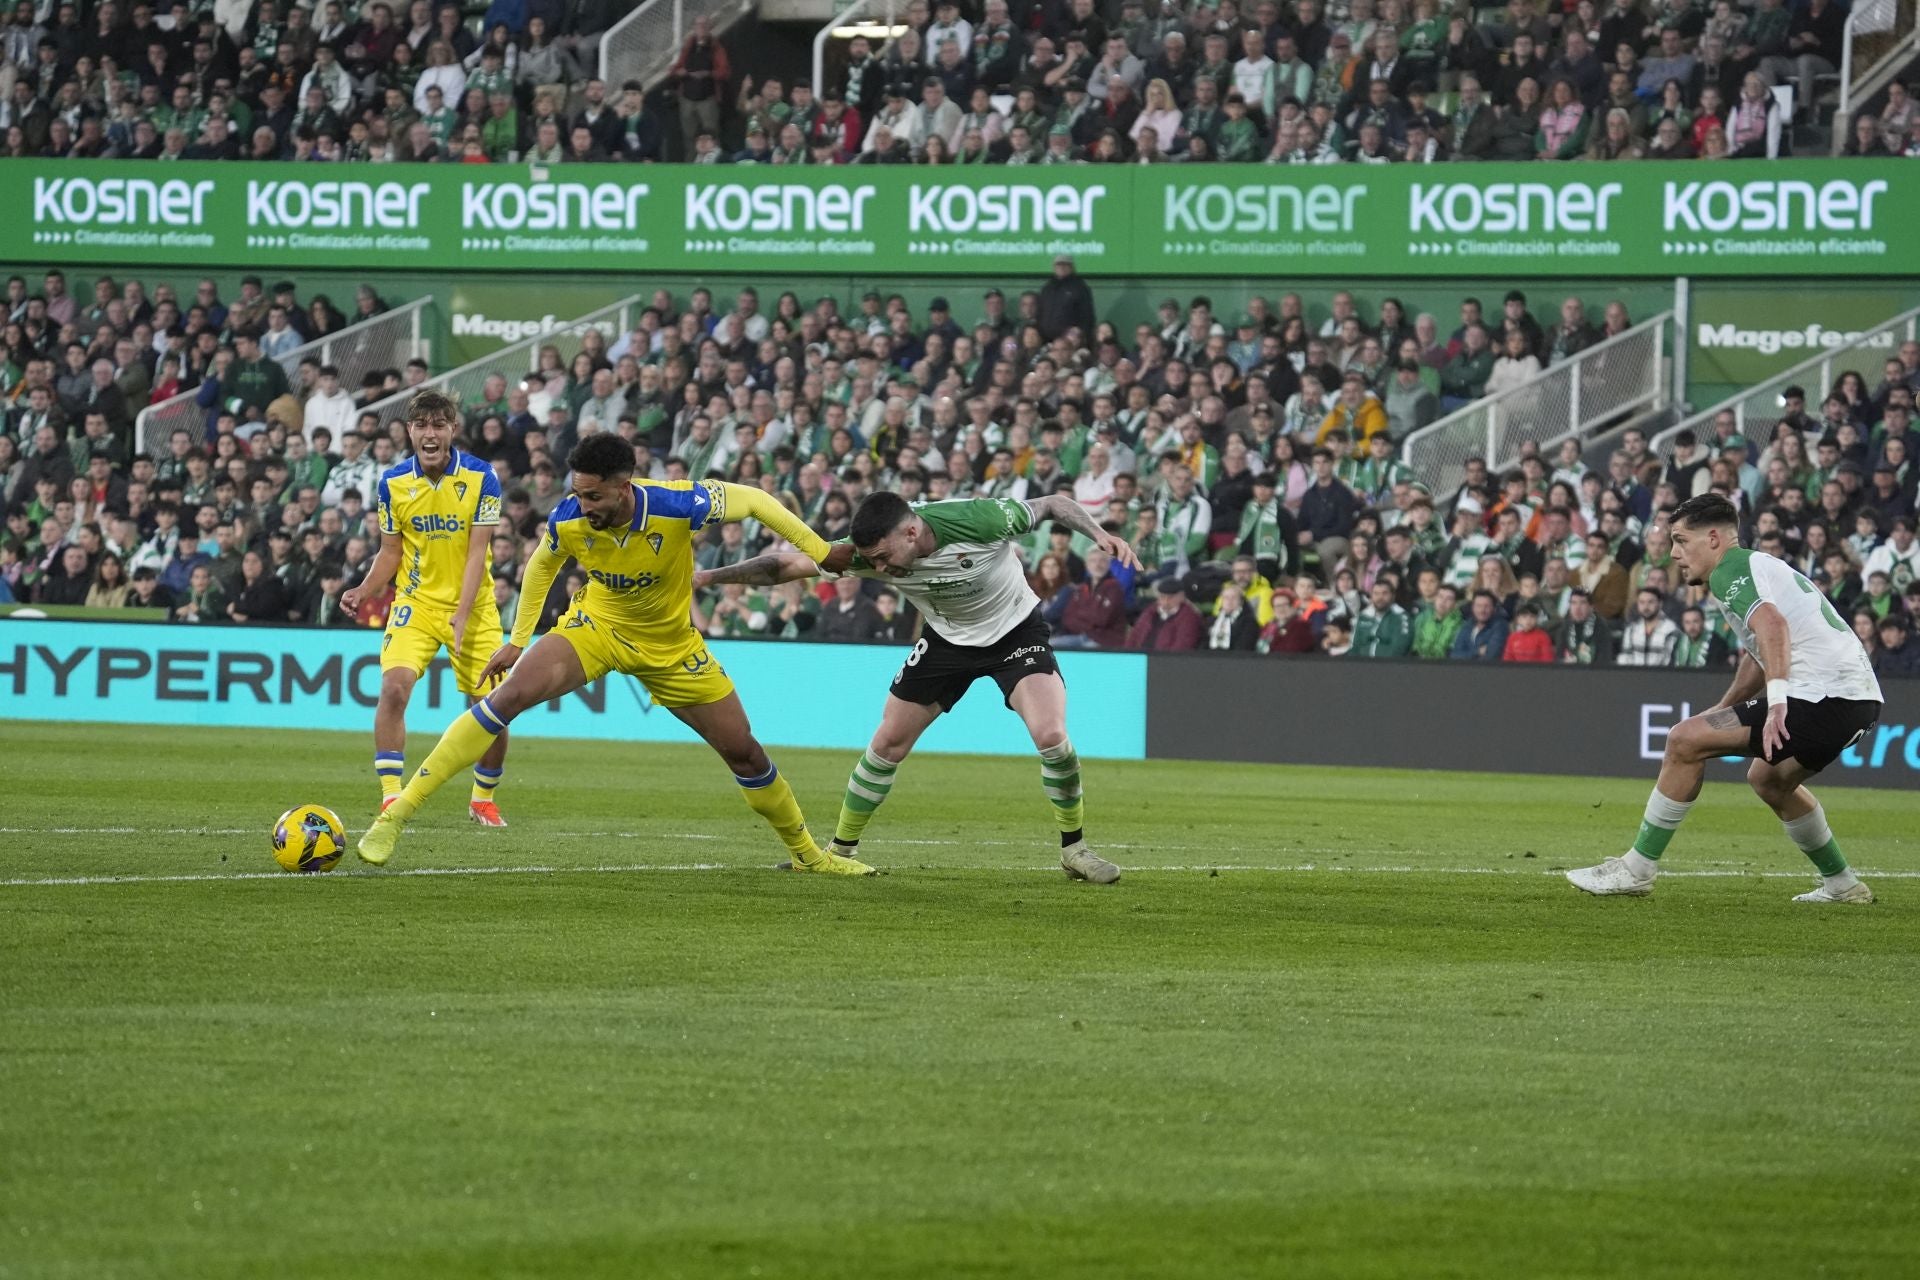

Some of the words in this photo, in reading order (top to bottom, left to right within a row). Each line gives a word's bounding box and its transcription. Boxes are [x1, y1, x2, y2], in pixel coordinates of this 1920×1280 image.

[75, 230, 158, 245] Climatización
[160, 231, 214, 246] eficiente
[289, 233, 373, 248] Climatización
[375, 234, 430, 249] eficiente
[504, 235, 590, 250] Climatización
[592, 236, 648, 251] eficiente
[728, 237, 816, 252] Climatización
[818, 238, 875, 254] eficiente
[953, 238, 1043, 254] Climatización
[1046, 239, 1105, 255] eficiente
[1713, 238, 1815, 255] Climatización
[1819, 238, 1886, 255] eficiente
[1456, 239, 1554, 255] Climatización
[1557, 239, 1621, 255] eficiente
[411, 514, 459, 532] Silbö
[1640, 703, 1691, 759] E
